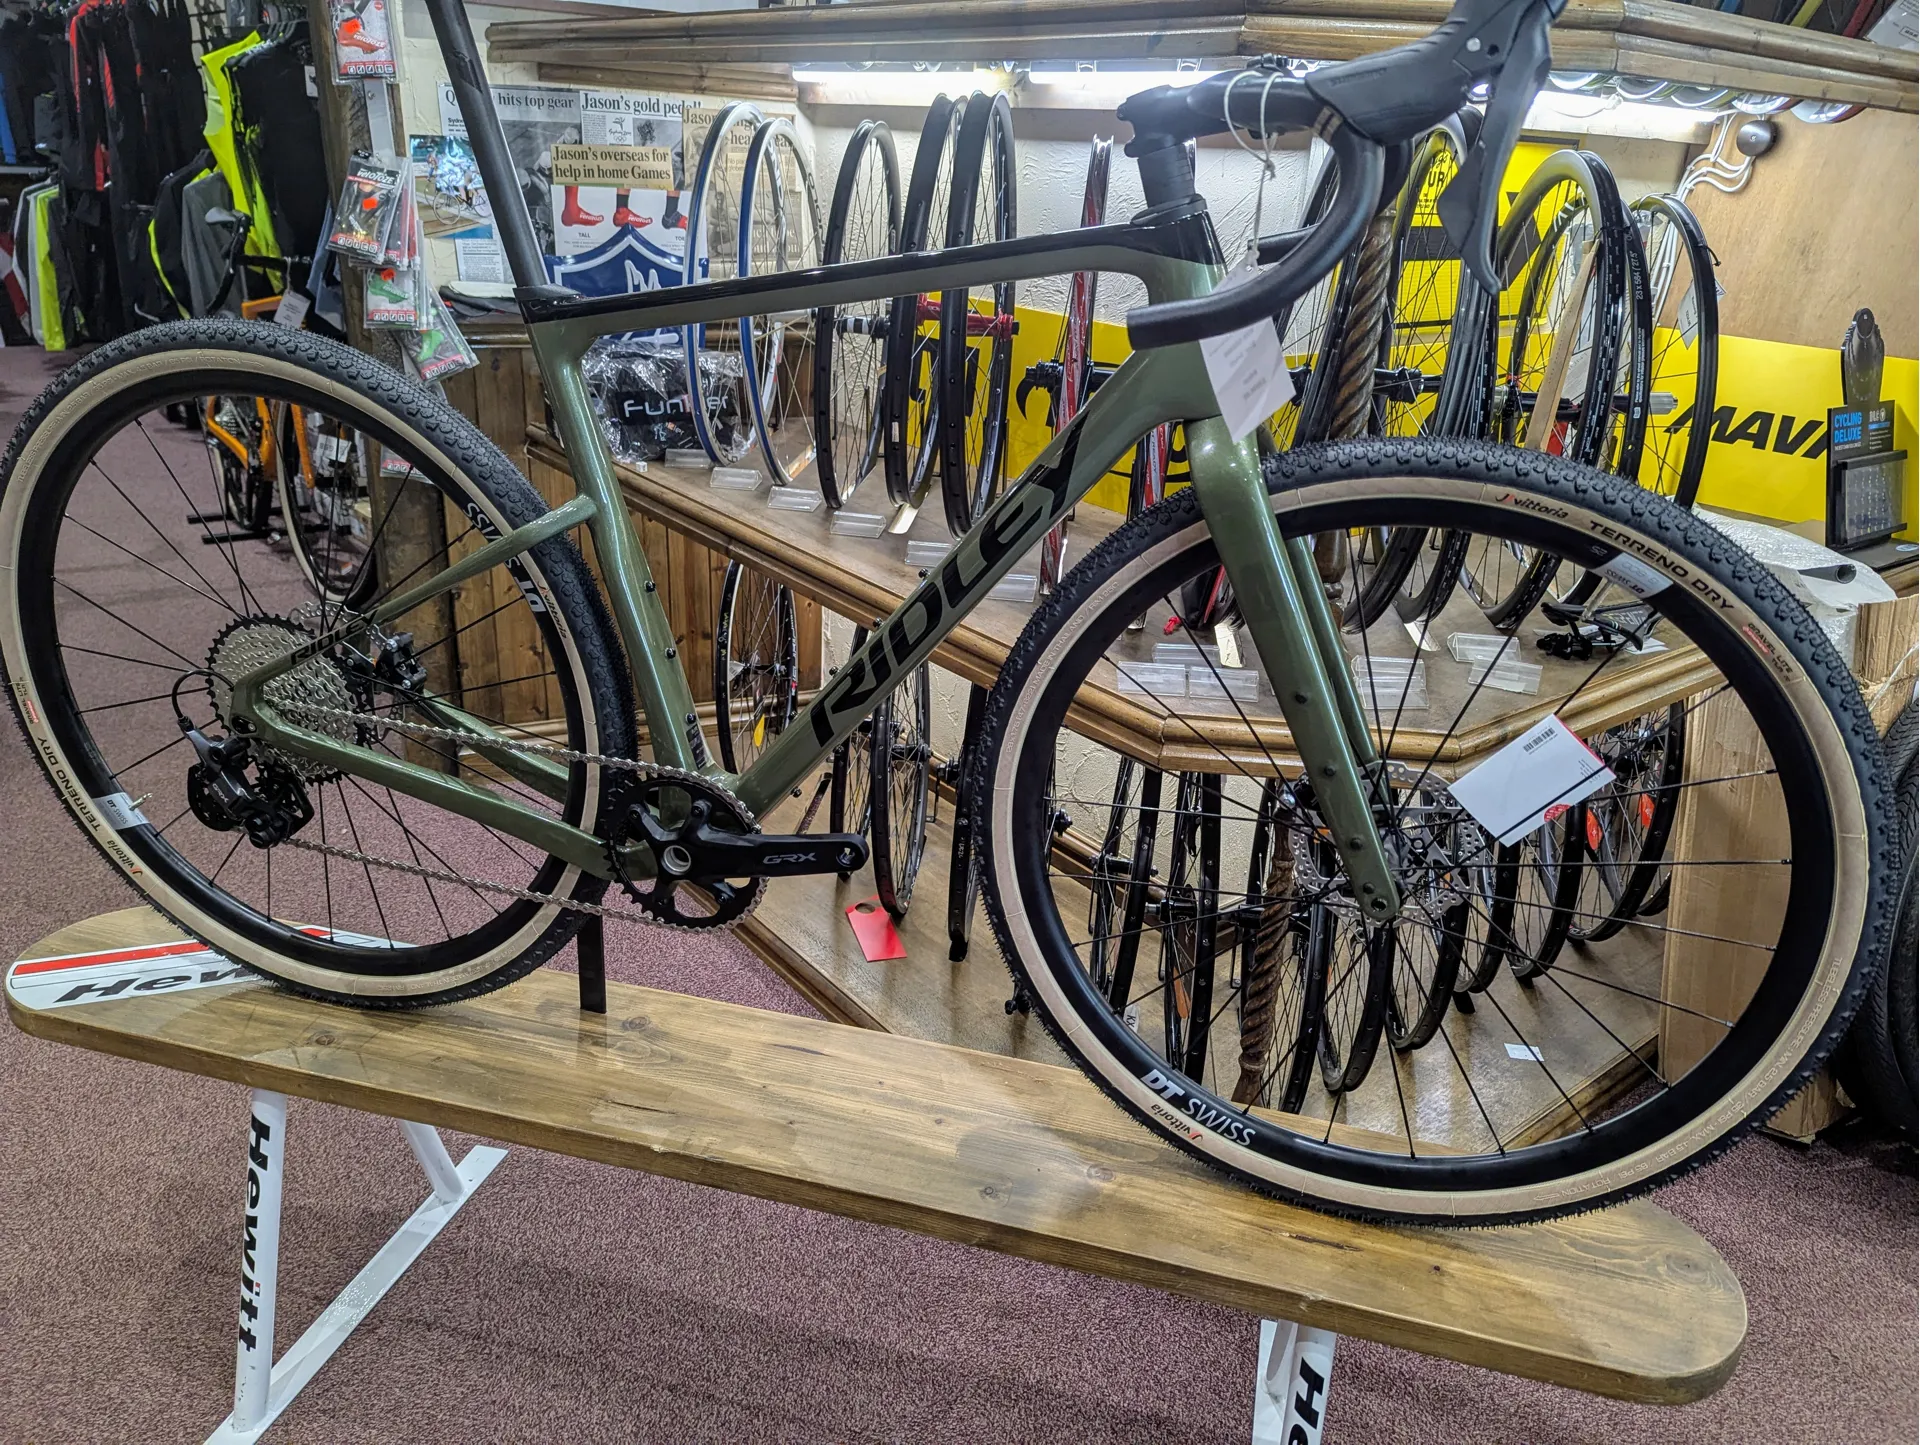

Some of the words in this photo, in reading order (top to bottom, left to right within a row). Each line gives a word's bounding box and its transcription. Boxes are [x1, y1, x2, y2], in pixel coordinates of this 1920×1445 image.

[498, 92, 522, 106] hits
[525, 95, 545, 109] top
[547, 97, 574, 110] gear
[582, 92, 631, 111] Jason's
[633, 98, 660, 115] gold
[553, 145, 598, 161] Jason's
[600, 150, 650, 162] overseas
[652, 147, 669, 163] for
[555, 164, 581, 181] help
[583, 165, 596, 179] in
[597, 164, 629, 179] home
[631, 165, 671, 180] Games
[1834, 411, 1862, 428] CYCLING
[1834, 427, 1862, 443] DELUXE
[1513, 496, 1569, 519] vittoria
[467, 502, 520, 570] SISS
[811, 409, 1090, 747] RIDLEY
[1589, 519, 1690, 578] TERRENO
[1691, 578, 1735, 610] DRY
[1604, 569, 1632, 588] SWISS
[514, 577, 547, 612] DT
[1629, 584, 1645, 595] DT
[544, 594, 567, 639] vittoria
[291, 609, 378, 665] RIDLEY
[1053, 614, 1086, 657] THAILAND
[1748, 623, 1776, 654] GRAVEL
[1777, 655, 1793, 674] LITE
[38, 736, 59, 767] DRY
[56, 769, 101, 832] TERRENO
[106, 840, 135, 870] vittoria
[763, 852, 816, 864] GRX
[1140, 1068, 1185, 1100] DT
[1181, 1098, 1256, 1146] SWISS
[1151, 1103, 1194, 1135] vittoria
[239, 1112, 271, 1352] Hewitt
